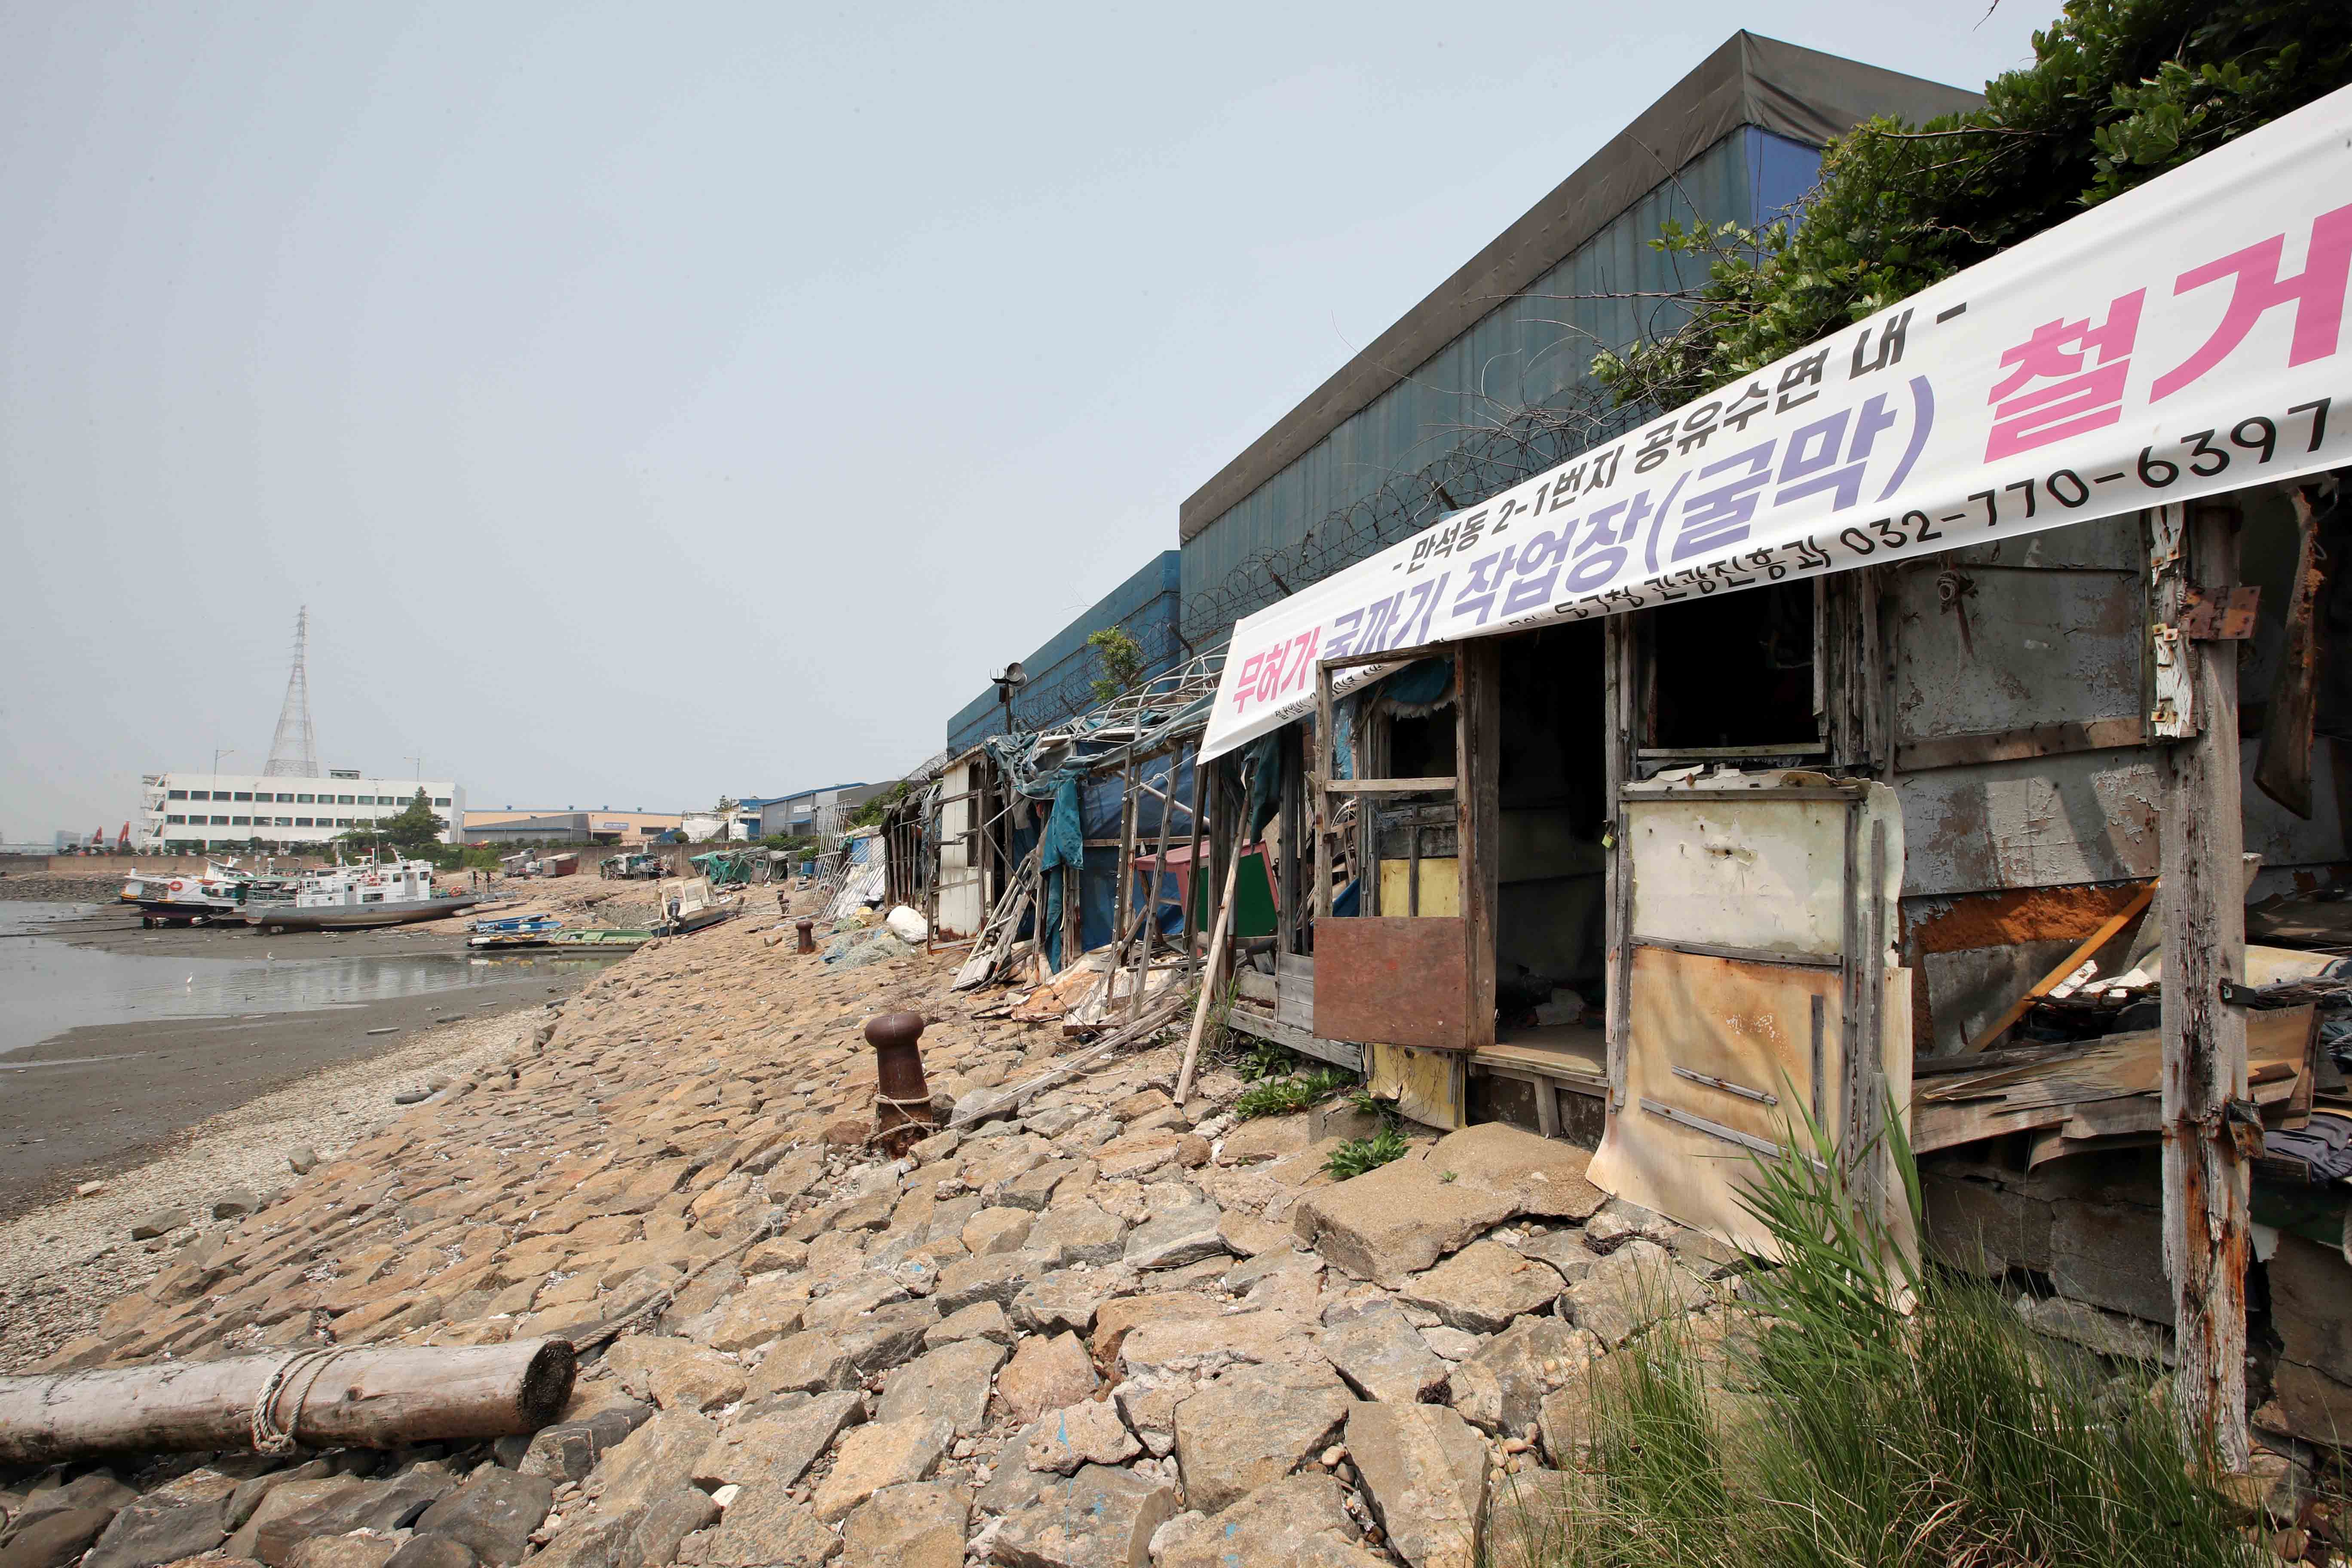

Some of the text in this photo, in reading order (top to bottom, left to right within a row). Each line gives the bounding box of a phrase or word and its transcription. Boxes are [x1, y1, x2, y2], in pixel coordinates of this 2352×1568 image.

[1232, 203, 2352, 713] 무허가 굴까기 작업장(굴막) 철거
[1406, 509, 1489, 575] 만석동
[1491, 444, 1625, 535] 2-1번지
[1634, 348, 1830, 474] 공유수면
[1849, 307, 1914, 380] 내
[1554, 585, 1645, 618] 동구청
[1840, 397, 2331, 555] 032-770-6397
